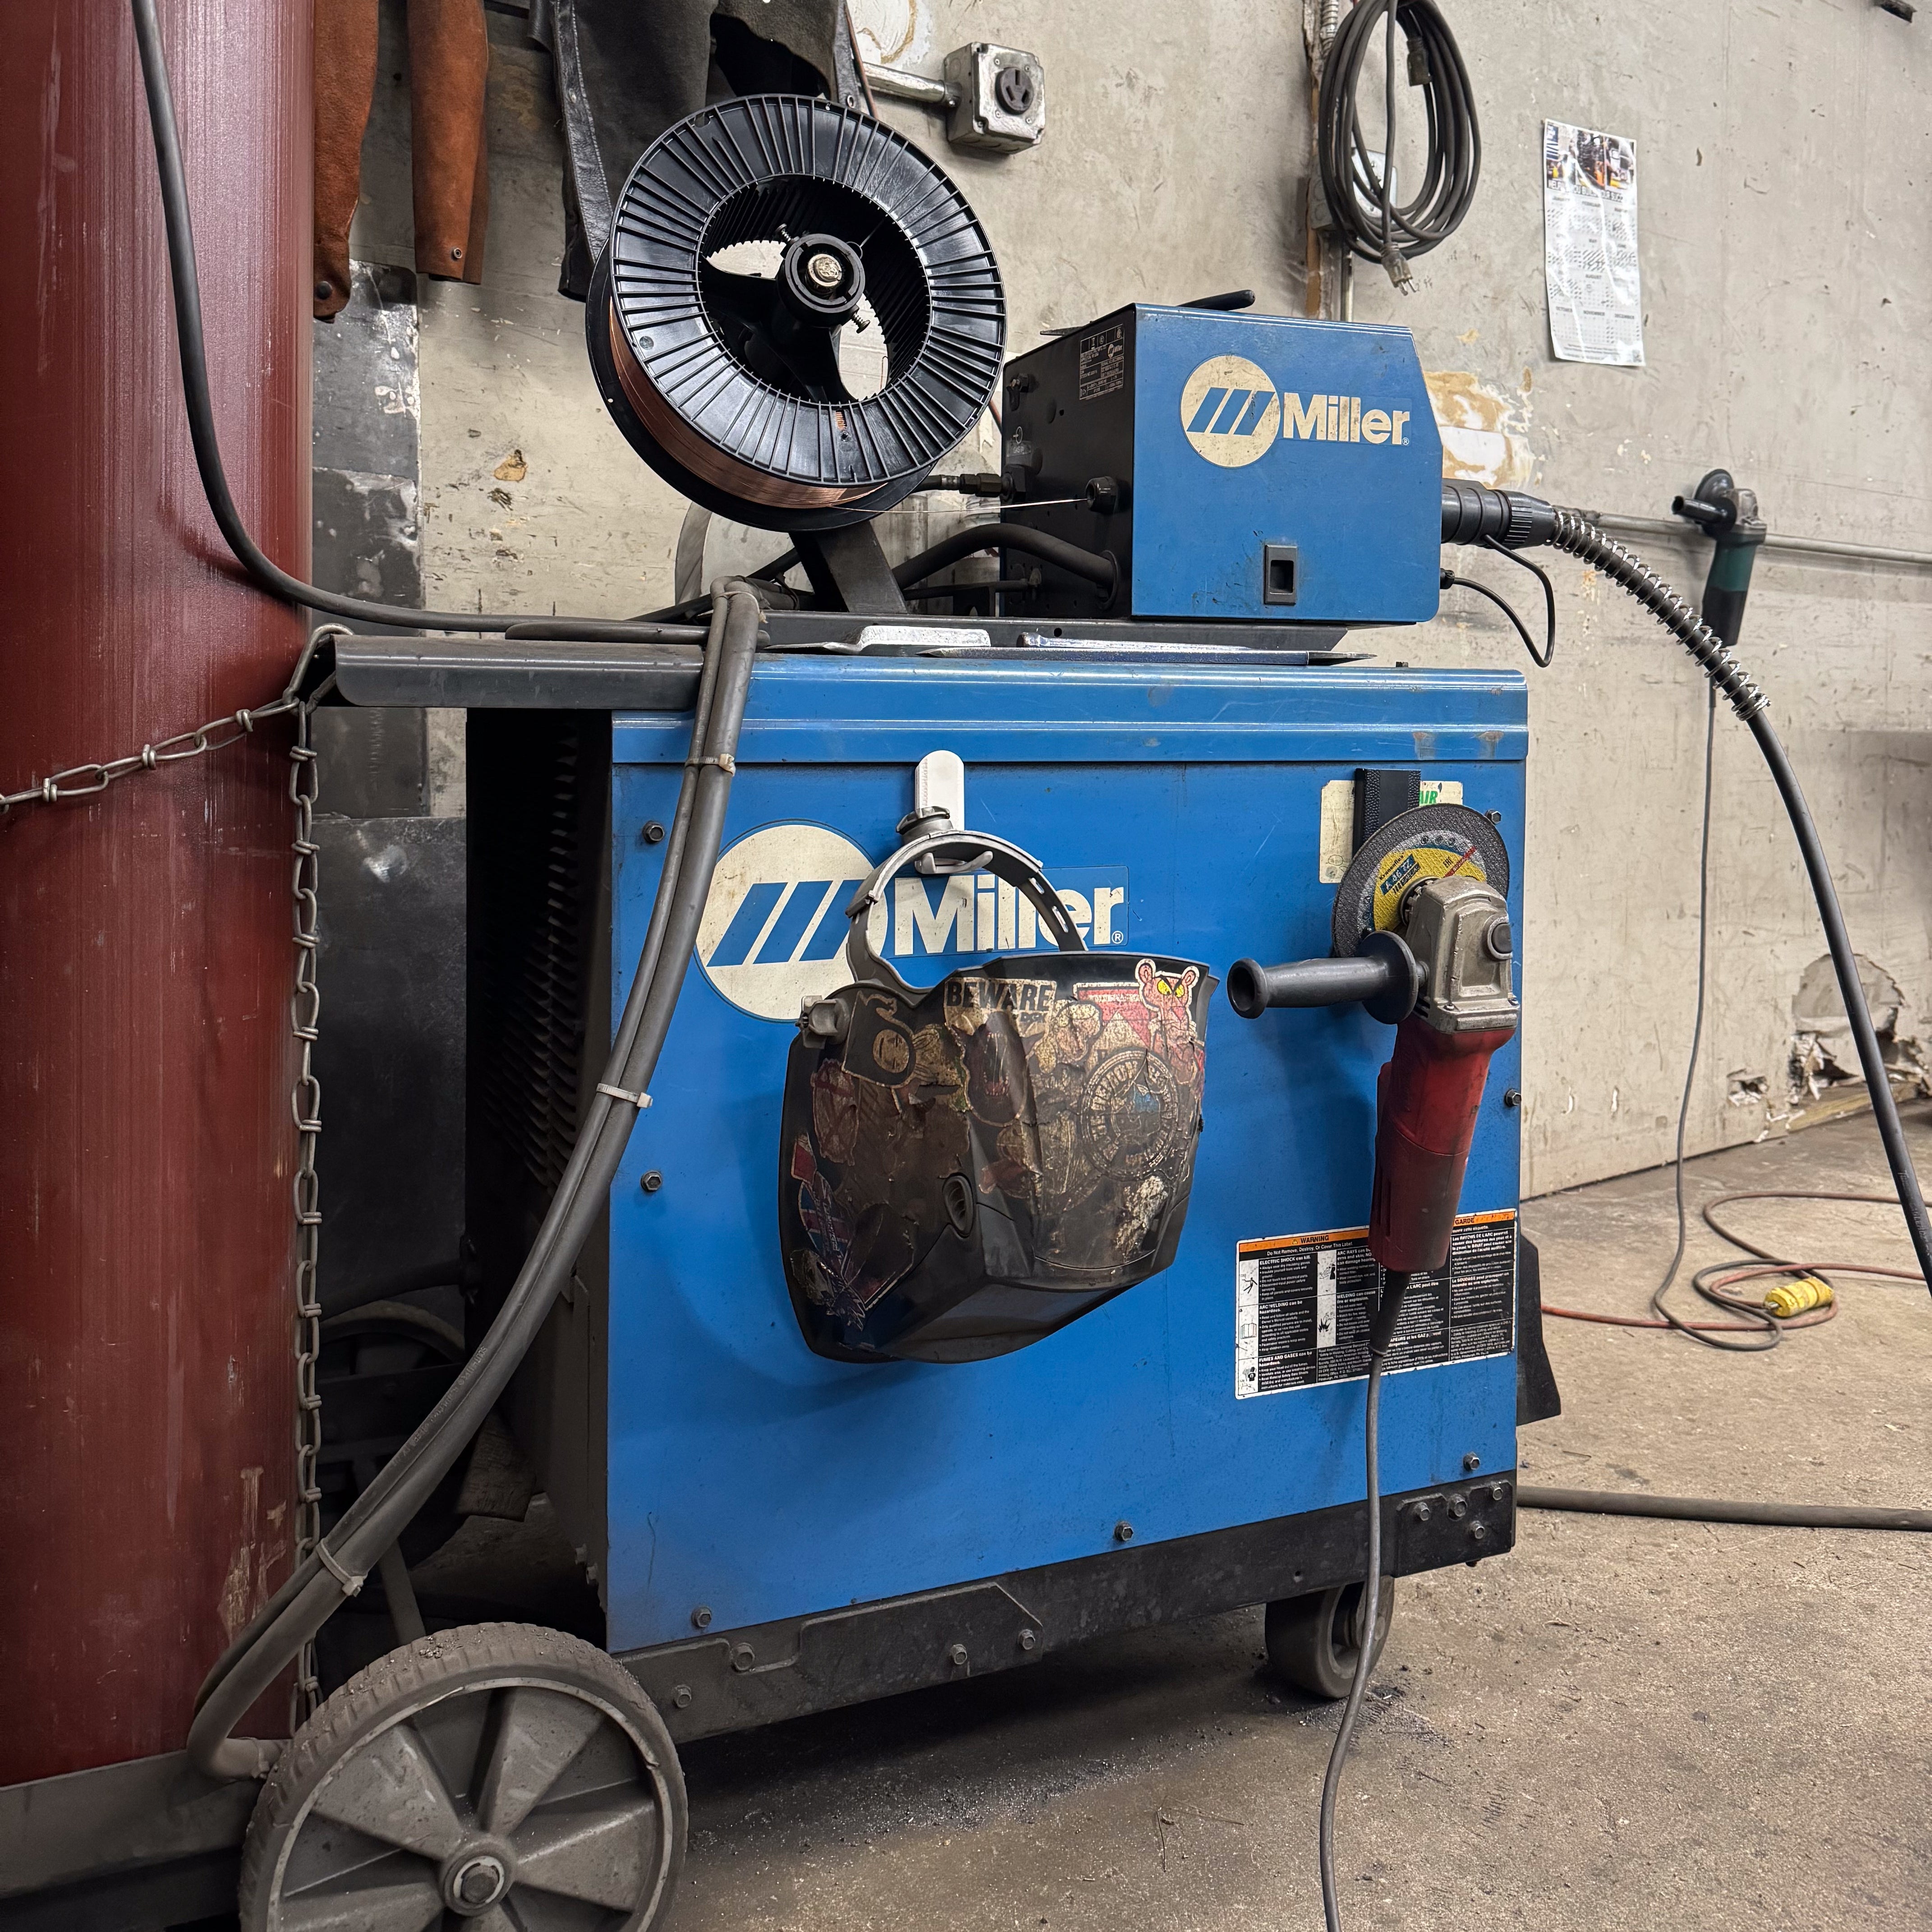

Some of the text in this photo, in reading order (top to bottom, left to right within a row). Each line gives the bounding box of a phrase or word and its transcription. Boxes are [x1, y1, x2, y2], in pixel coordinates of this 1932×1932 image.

[1283, 392, 1410, 445] Miller
[946, 981, 1056, 1012] BEWARE
[1301, 1235, 1329, 1244] WARNING
